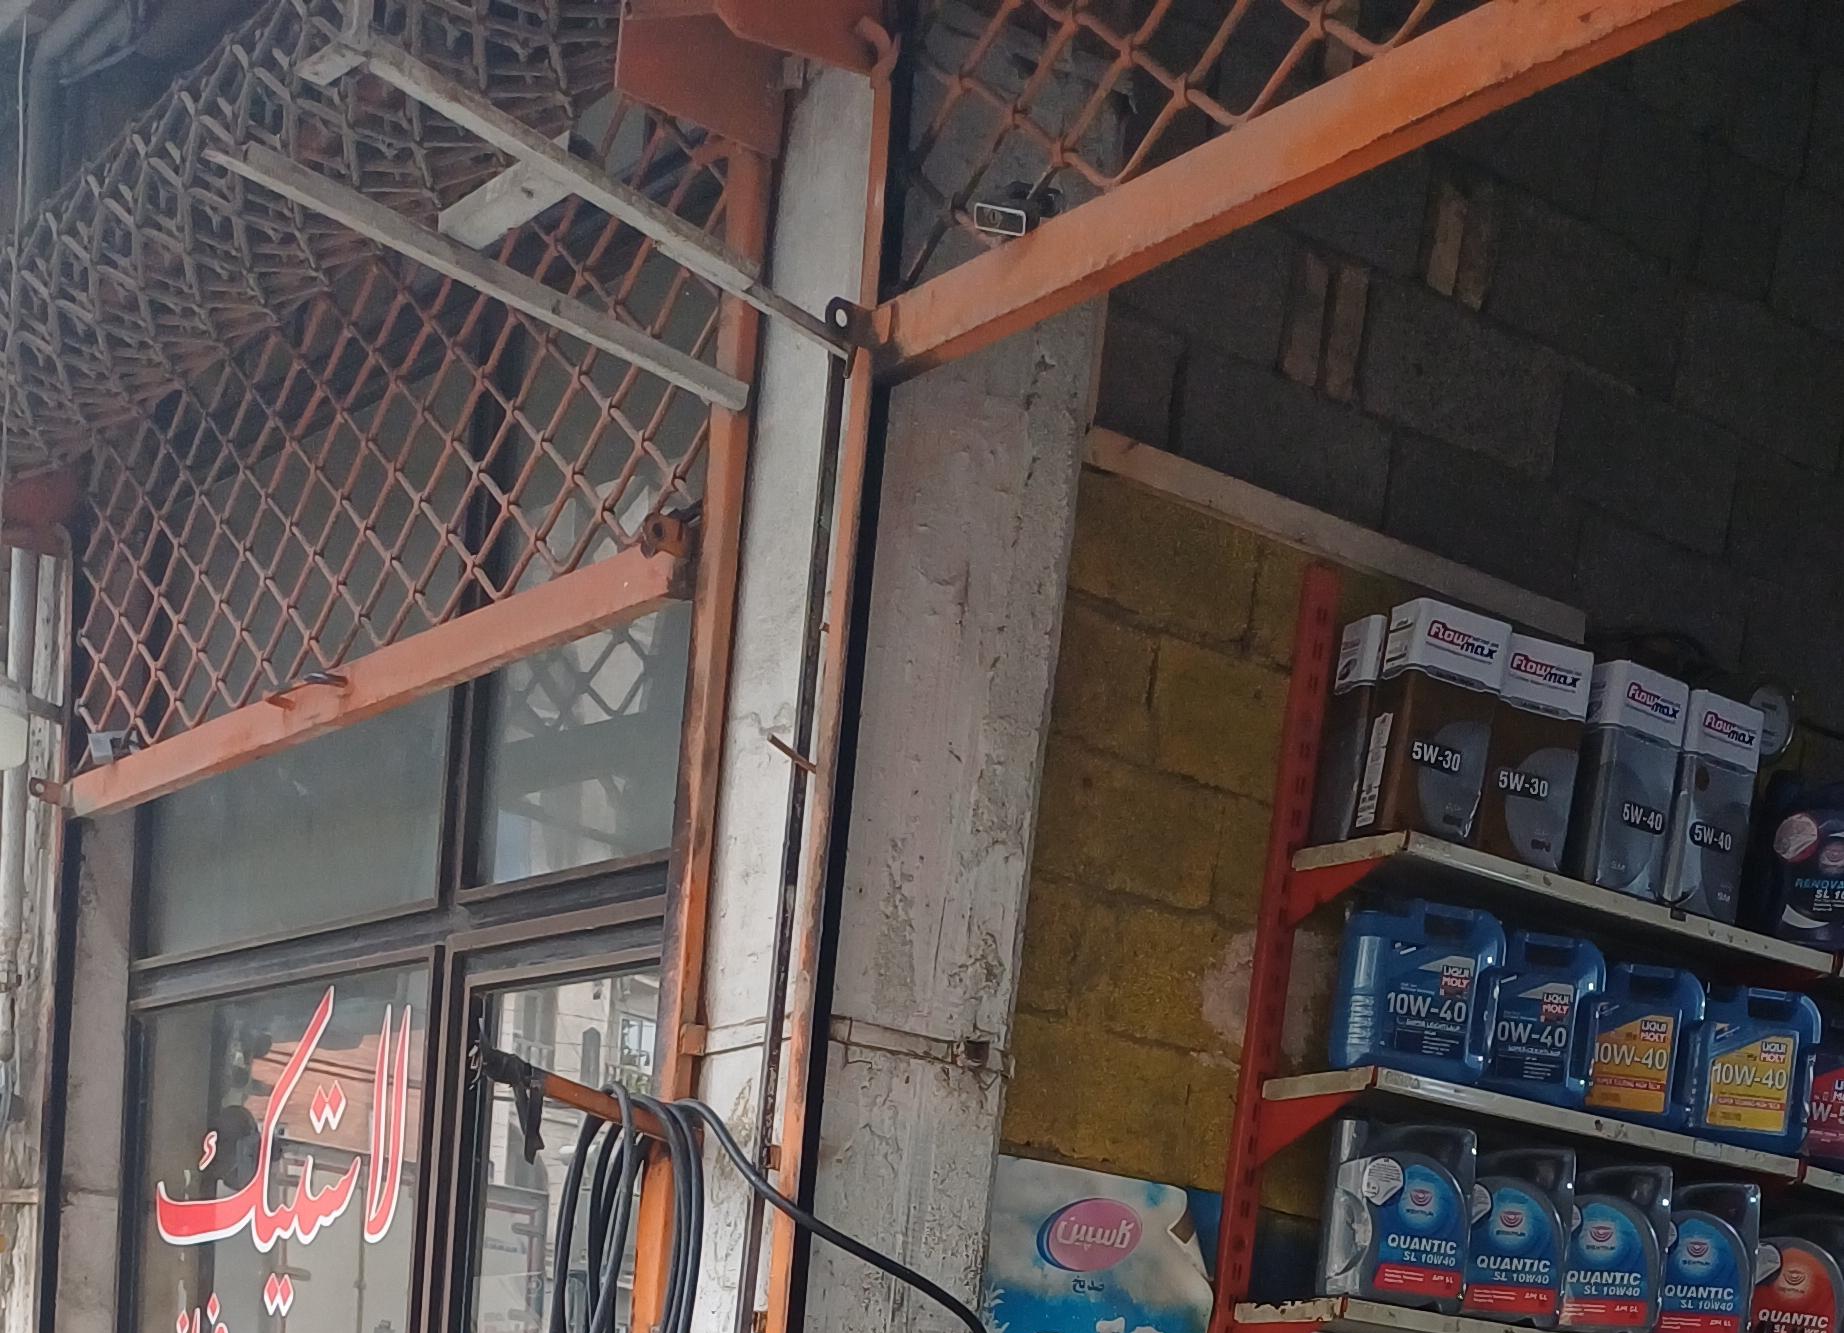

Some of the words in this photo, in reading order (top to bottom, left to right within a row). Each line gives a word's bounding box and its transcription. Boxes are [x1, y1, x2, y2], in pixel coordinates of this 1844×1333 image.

[1412, 741, 1461, 772] 5W-30
[1499, 770, 1549, 797] 5W-30
[1623, 803, 1663, 831] 5W-40
[1694, 824, 1732, 850] 5W-40
[1441, 978, 1470, 988] MOLY
[1387, 991, 1467, 1023] 10W-40
[1542, 1003, 1568, 1014] MOLY
[1497, 1020, 1567, 1047] 0W-40
[1641, 1020, 1667, 1032] LIQUI
[1641, 1031, 1665, 1043] MOLY
[1762, 1042, 1786, 1053] LIQUI
[1760, 1053, 1786, 1063] MOLY
[1713, 1062, 1787, 1090] 10W-40
[1056, 1217, 1135, 1251] کاسپین
[1388, 1233, 1457, 1255] QUANTIC
[1403, 1251, 1417, 1262] SL
[1421, 1253, 1456, 1267] 10W40
[1476, 1255, 1551, 1273] QUANTIC
[1494, 1270, 1508, 1281] SL
[1512, 1273, 1549, 1284] 10W40
[1566, 1270, 1641, 1286] QUANTIC
[1583, 1285, 1598, 1295] SL
[1603, 1285, 1641, 1297] 10W40
[1664, 1284, 1734, 1301] QUANTIC
[1680, 1299, 1694, 1309] SL
[1699, 1300, 1733, 1312] 10W40
[1758, 1309, 1829, 1329] QUANTIC
